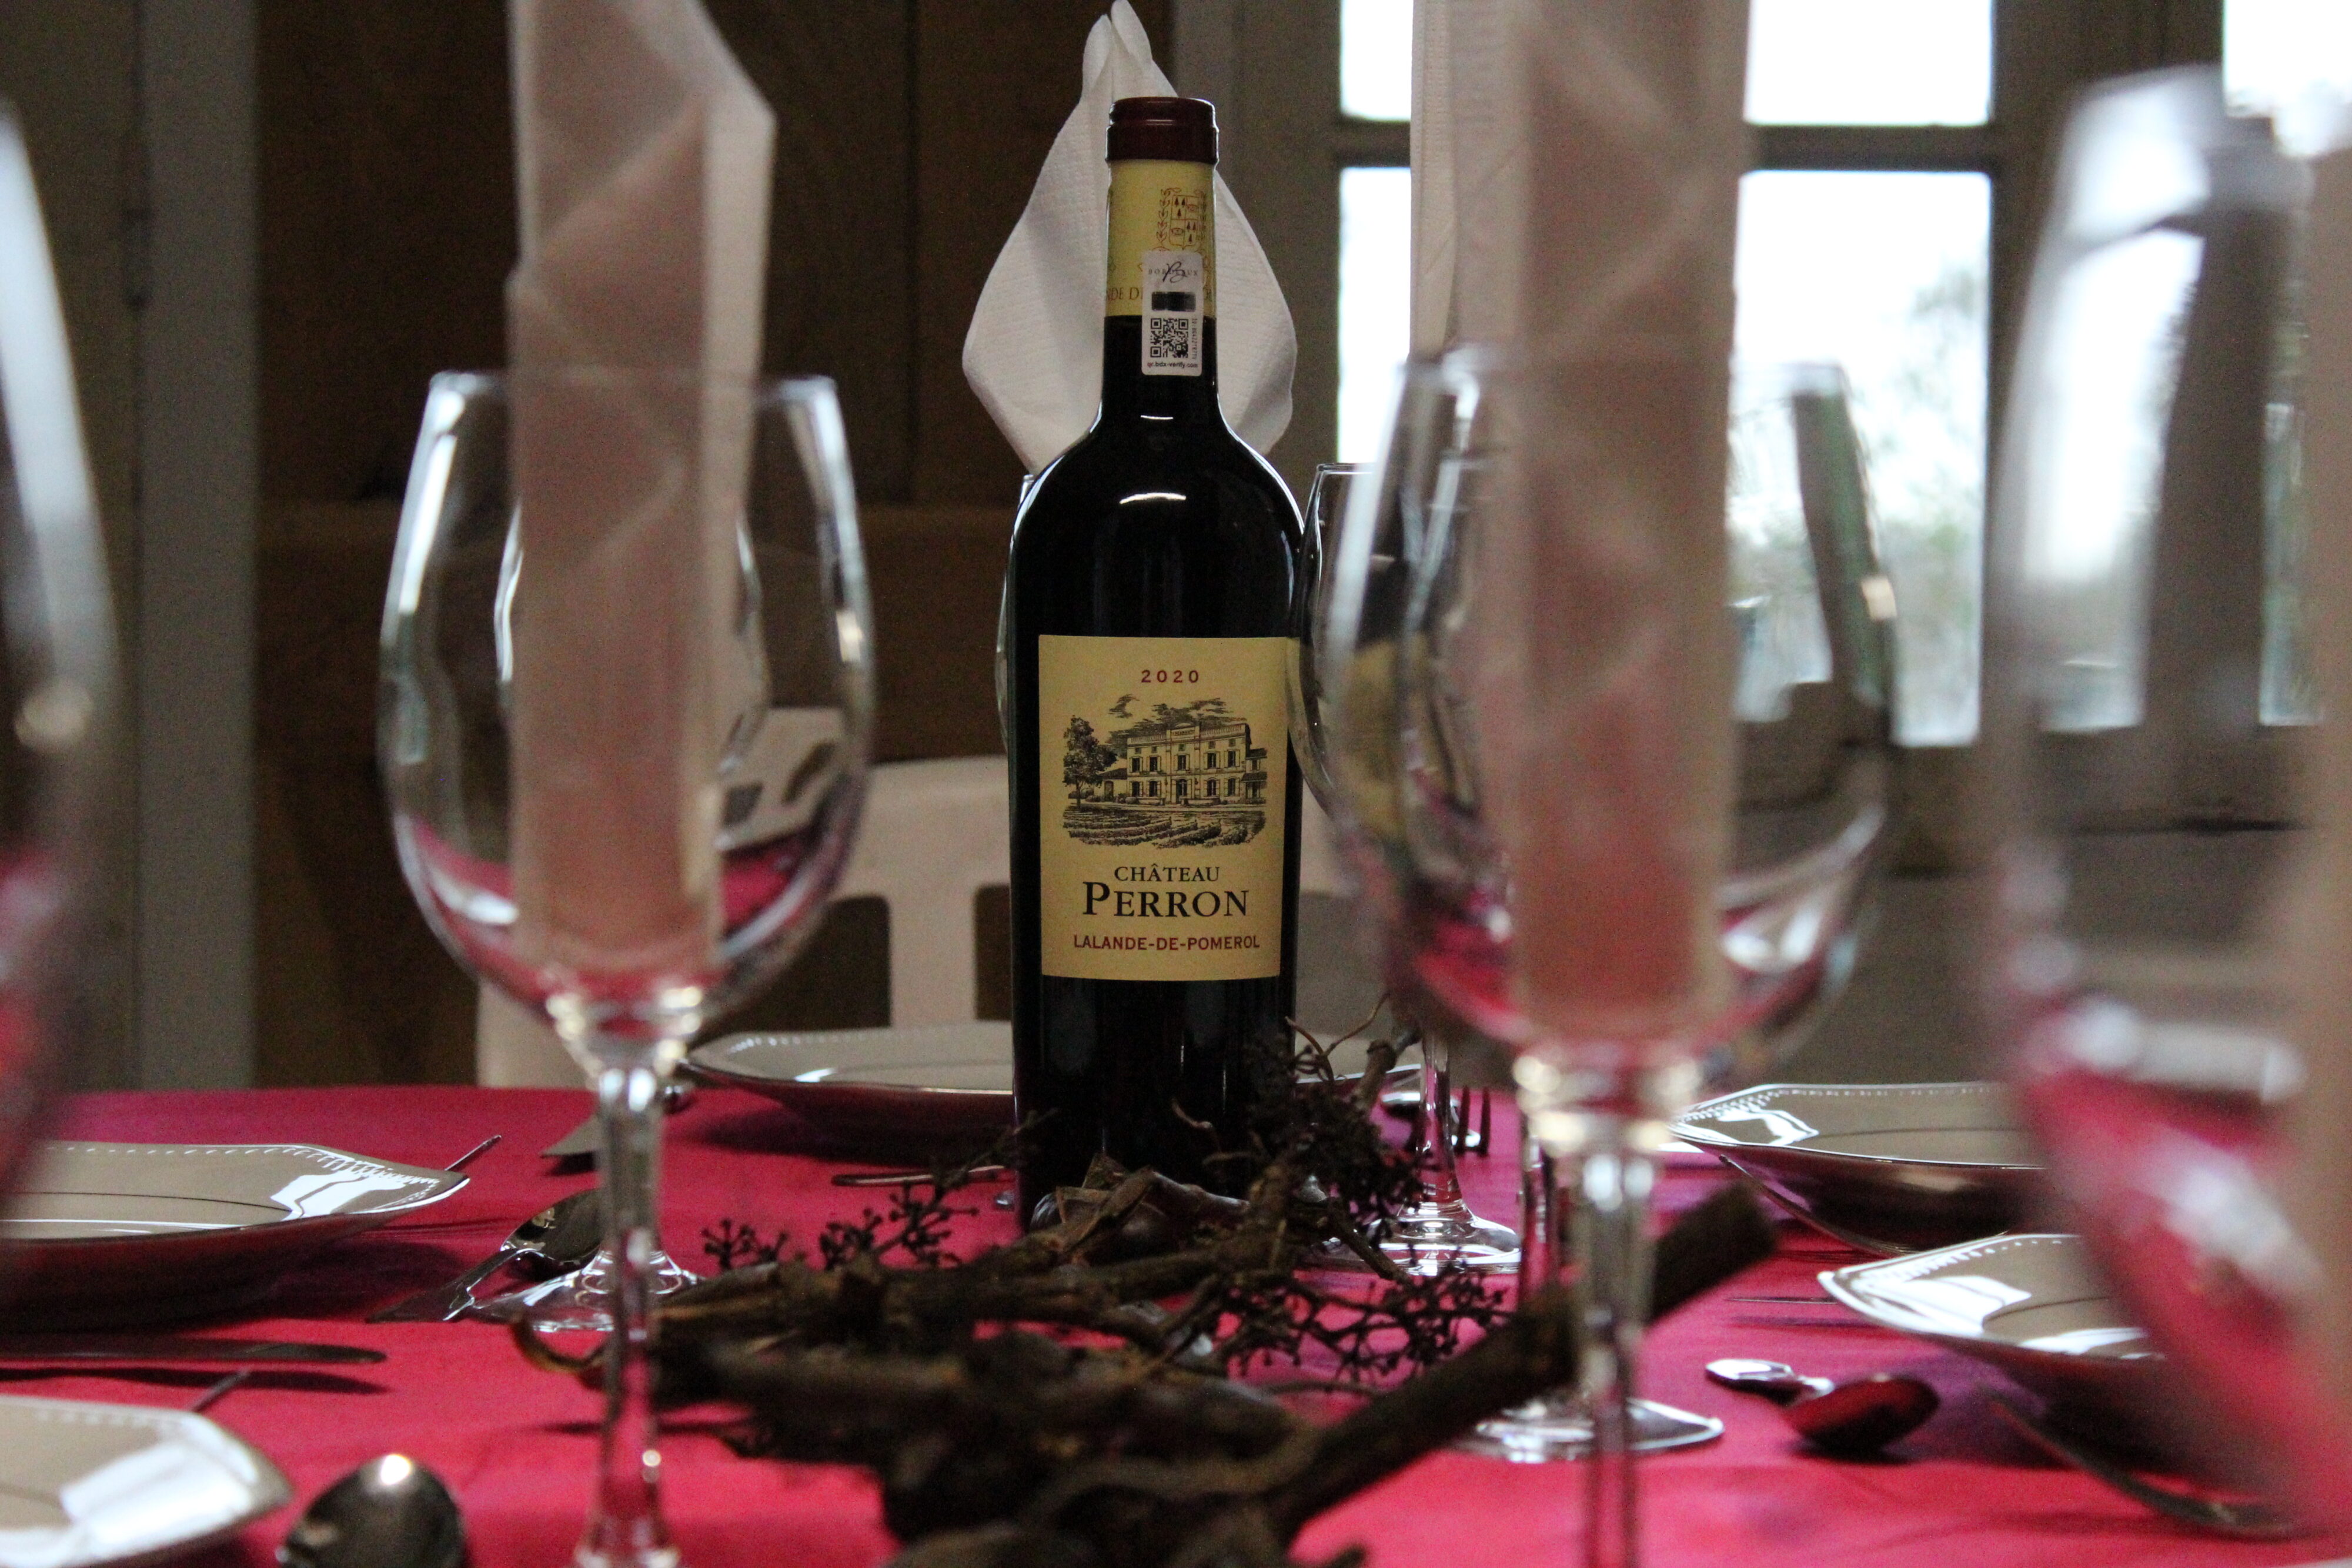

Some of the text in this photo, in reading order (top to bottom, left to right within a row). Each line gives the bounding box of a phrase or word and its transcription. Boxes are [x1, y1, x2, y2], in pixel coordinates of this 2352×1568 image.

[1141, 670, 1199, 683] 2020
[1114, 864, 1220, 881] CHÂTEAU
[1083, 881, 1248, 917] PERRON
[1074, 935, 1259, 950] LALANDE-DE-POMEROL
